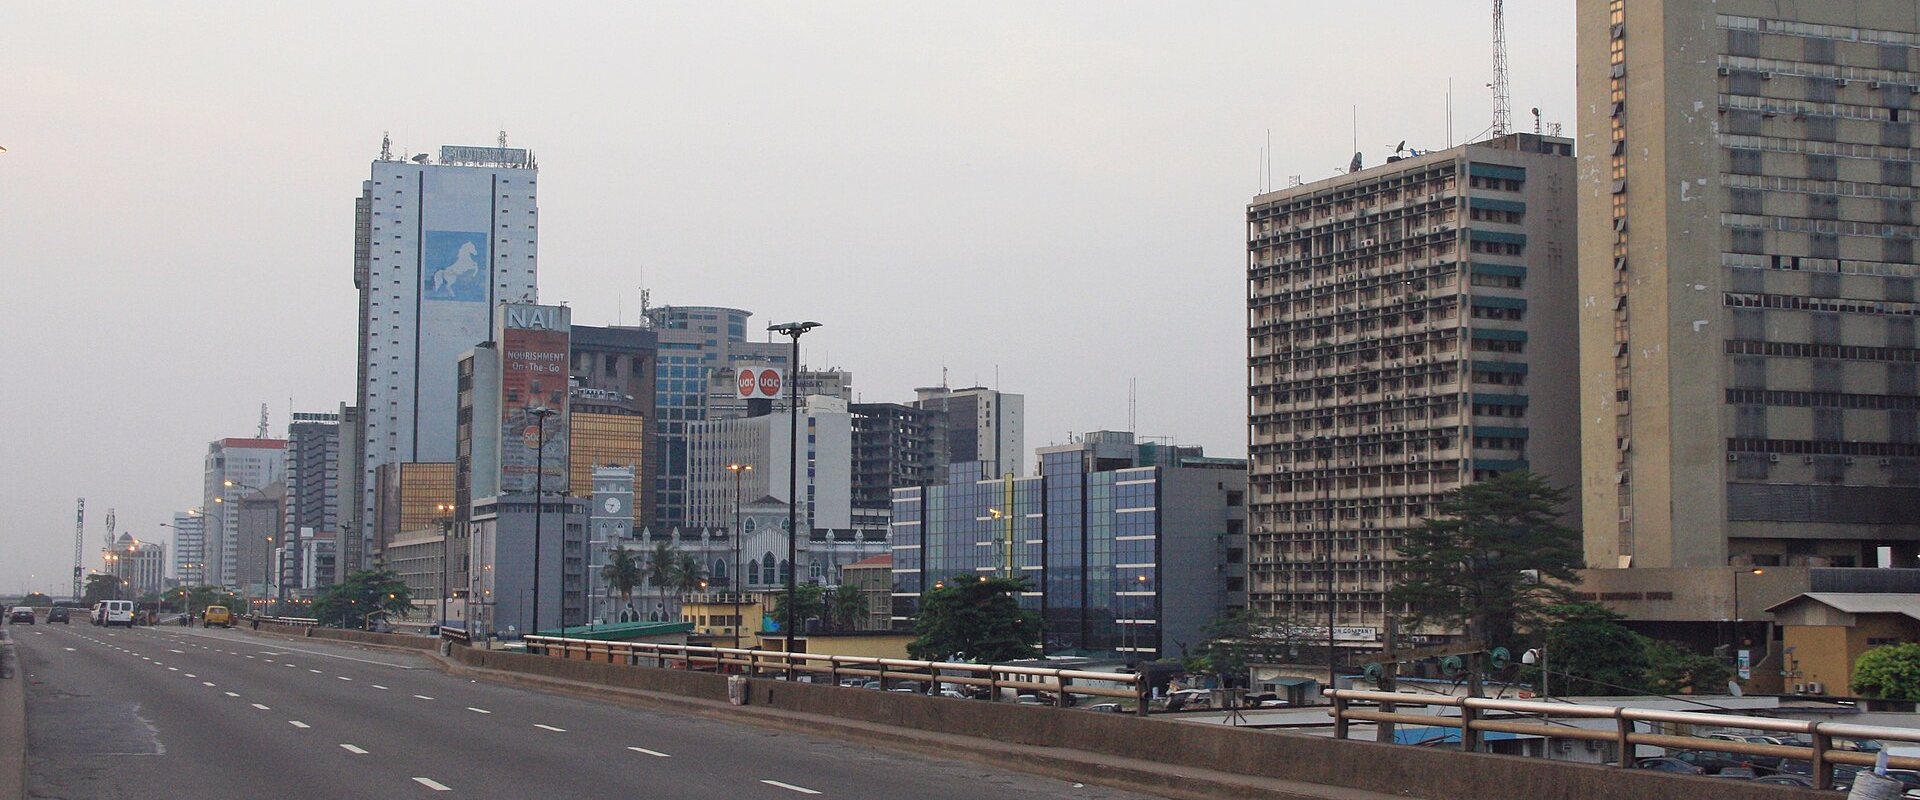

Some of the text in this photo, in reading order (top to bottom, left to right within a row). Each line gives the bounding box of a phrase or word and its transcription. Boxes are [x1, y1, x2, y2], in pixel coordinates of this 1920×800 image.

[507, 351, 564, 361] NOURISHMENT
[740, 378, 754, 387] uac
[761, 378, 779, 388] uac
